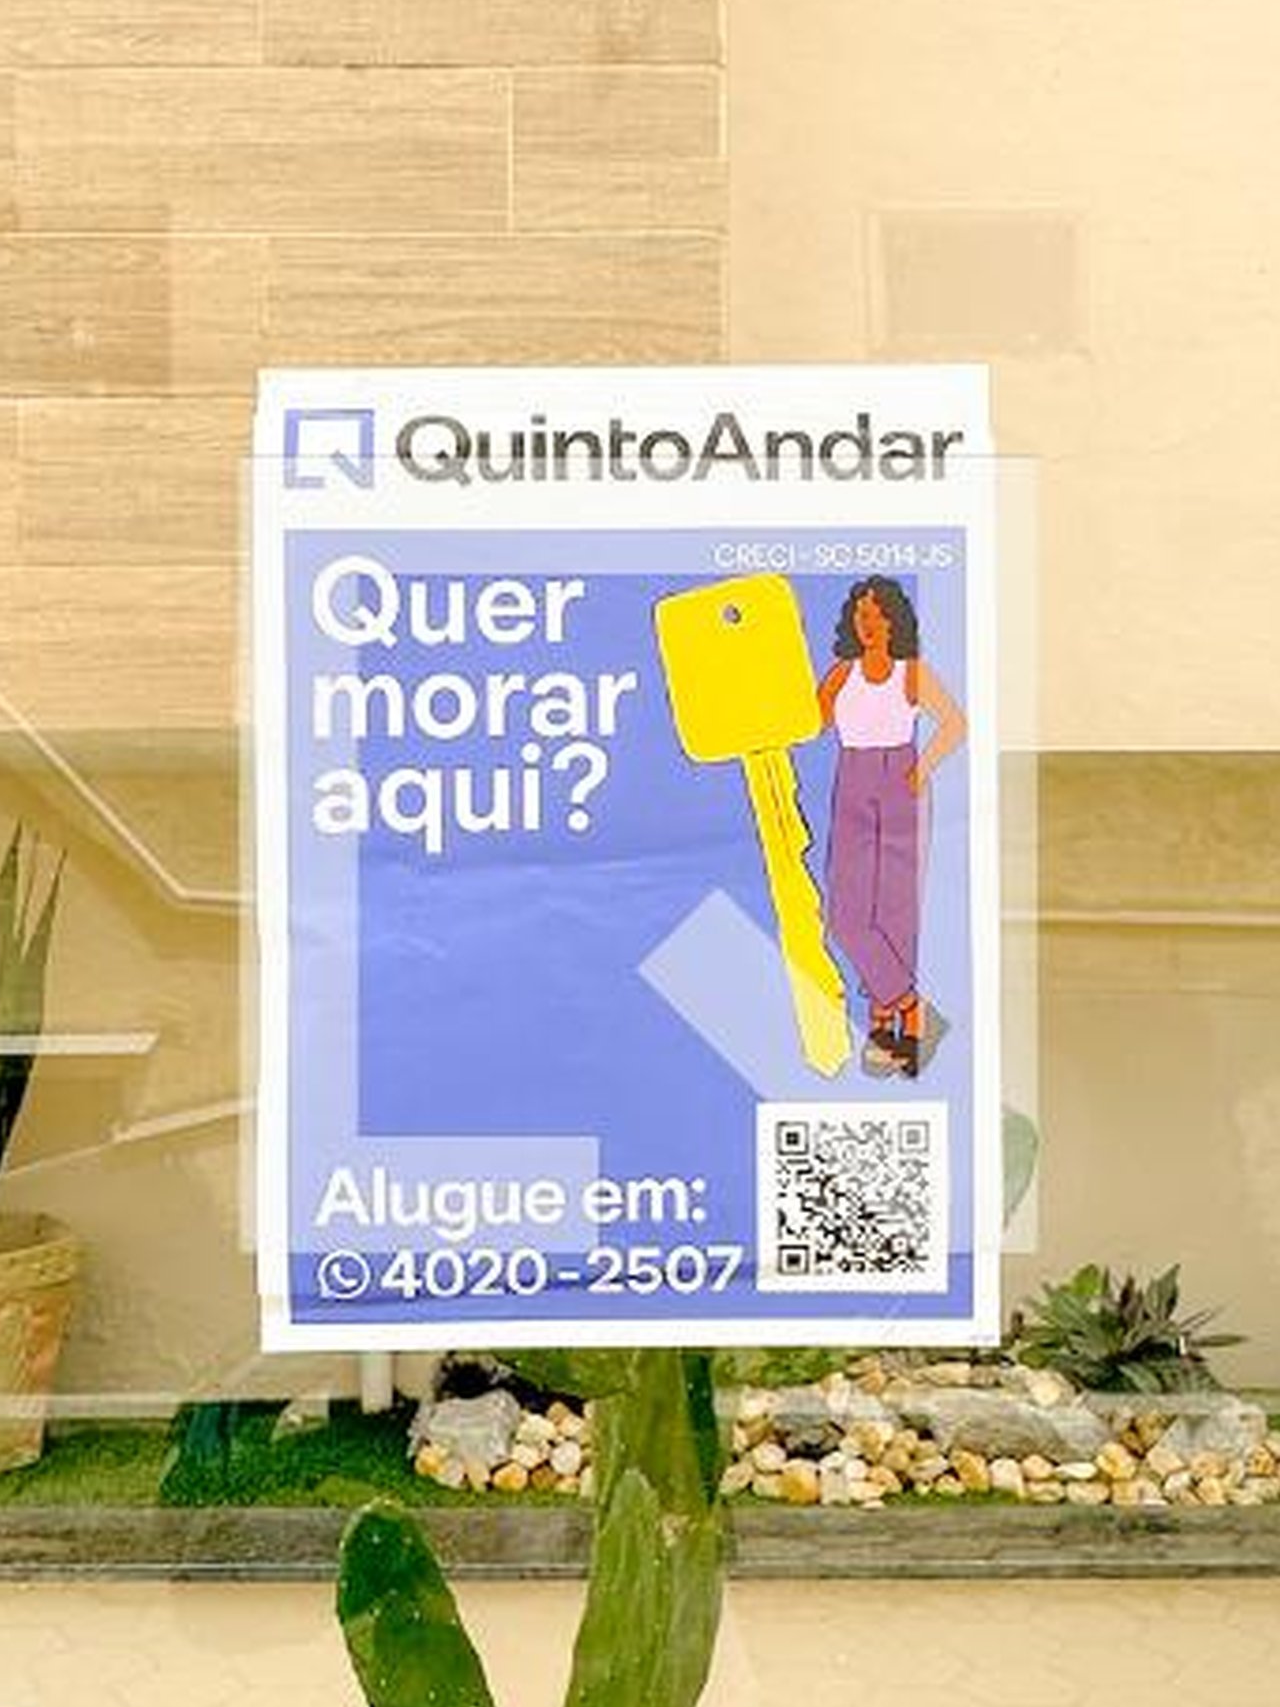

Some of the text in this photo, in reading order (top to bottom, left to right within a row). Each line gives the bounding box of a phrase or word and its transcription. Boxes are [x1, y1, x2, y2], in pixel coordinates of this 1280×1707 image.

[395, 411, 963, 487] QuintoAndar
[312, 556, 584, 647] Quer
[312, 668, 638, 739] morar
[312, 743, 609, 854] aqui?
[314, 1167, 708, 1243] Alugue em:
